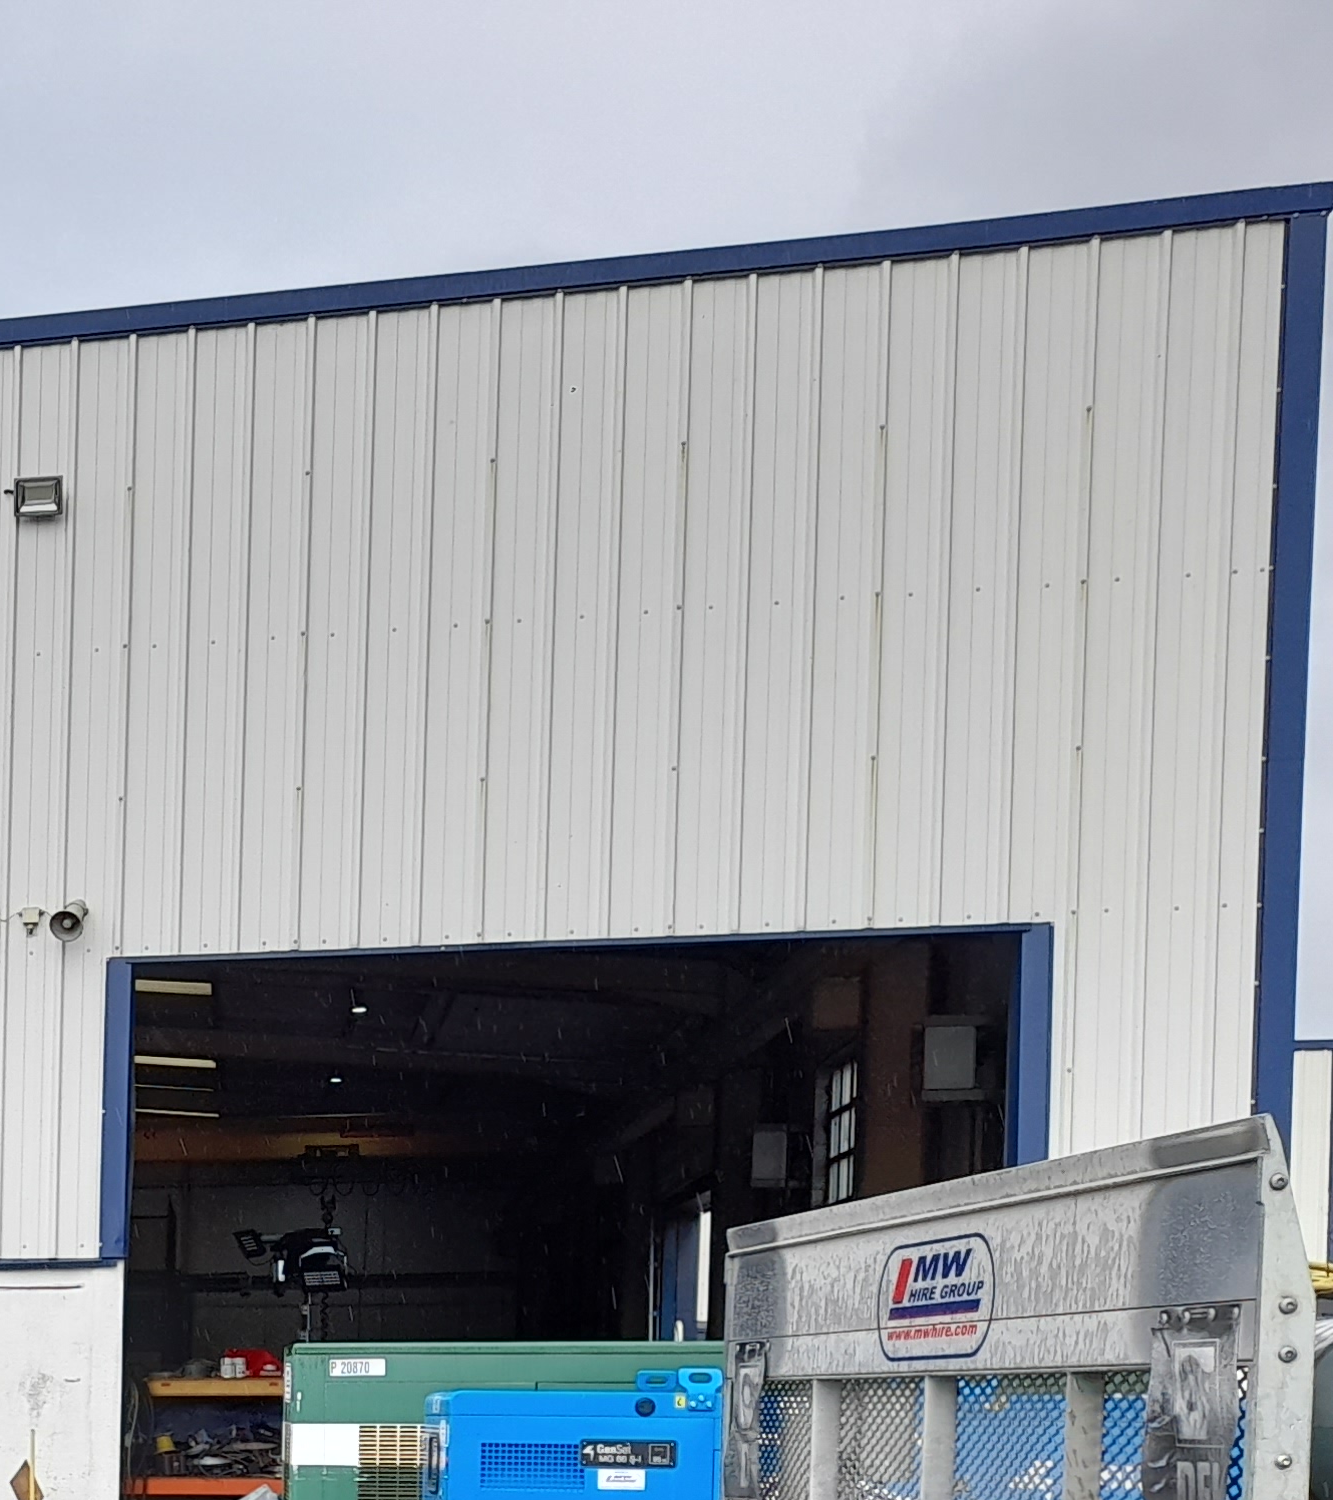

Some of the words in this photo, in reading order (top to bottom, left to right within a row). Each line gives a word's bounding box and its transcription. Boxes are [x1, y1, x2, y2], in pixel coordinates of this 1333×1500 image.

[913, 1248, 973, 1283] MW
[908, 1286, 937, 1303] HIRE
[940, 1280, 984, 1299] GROUP
[887, 1324, 978, 1341] www.mwhire.com
[341, 1361, 370, 1374] 20870
